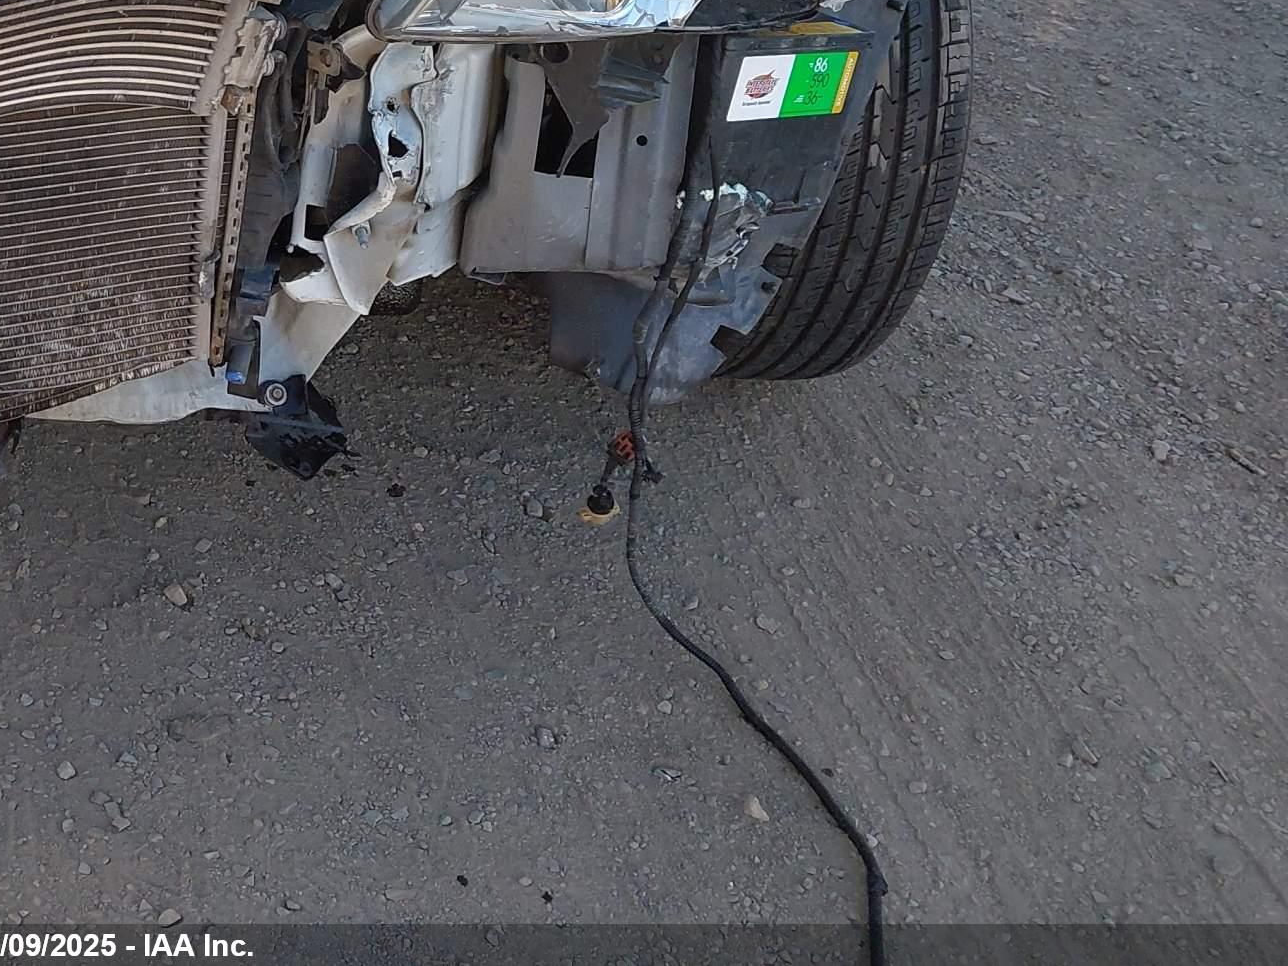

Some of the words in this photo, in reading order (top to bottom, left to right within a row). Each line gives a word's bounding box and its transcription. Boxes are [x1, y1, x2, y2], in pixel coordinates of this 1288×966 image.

[814, 57, 829, 73] 86
[810, 73, 830, 88] 590
[835, 57, 855, 107] AUTOMOTIVE
